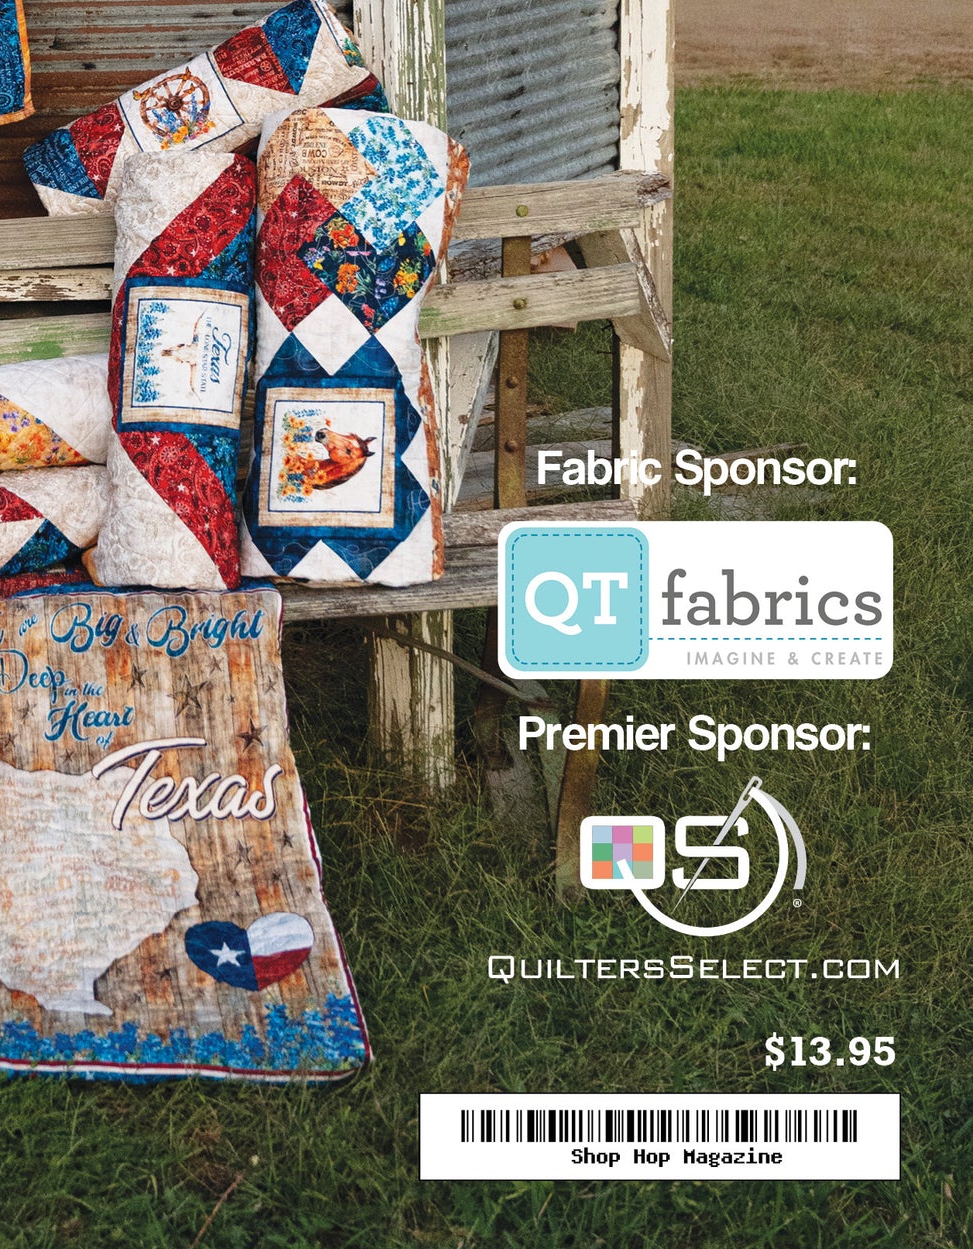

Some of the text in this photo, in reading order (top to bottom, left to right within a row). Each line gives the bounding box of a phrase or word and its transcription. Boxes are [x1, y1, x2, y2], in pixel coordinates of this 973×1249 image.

[210, 326, 233, 385] Texas
[50, 602, 124, 653] Big
[145, 605, 266, 658] Bright
[44, 700, 136, 741] Heart
[91, 737, 283, 831] Texas
